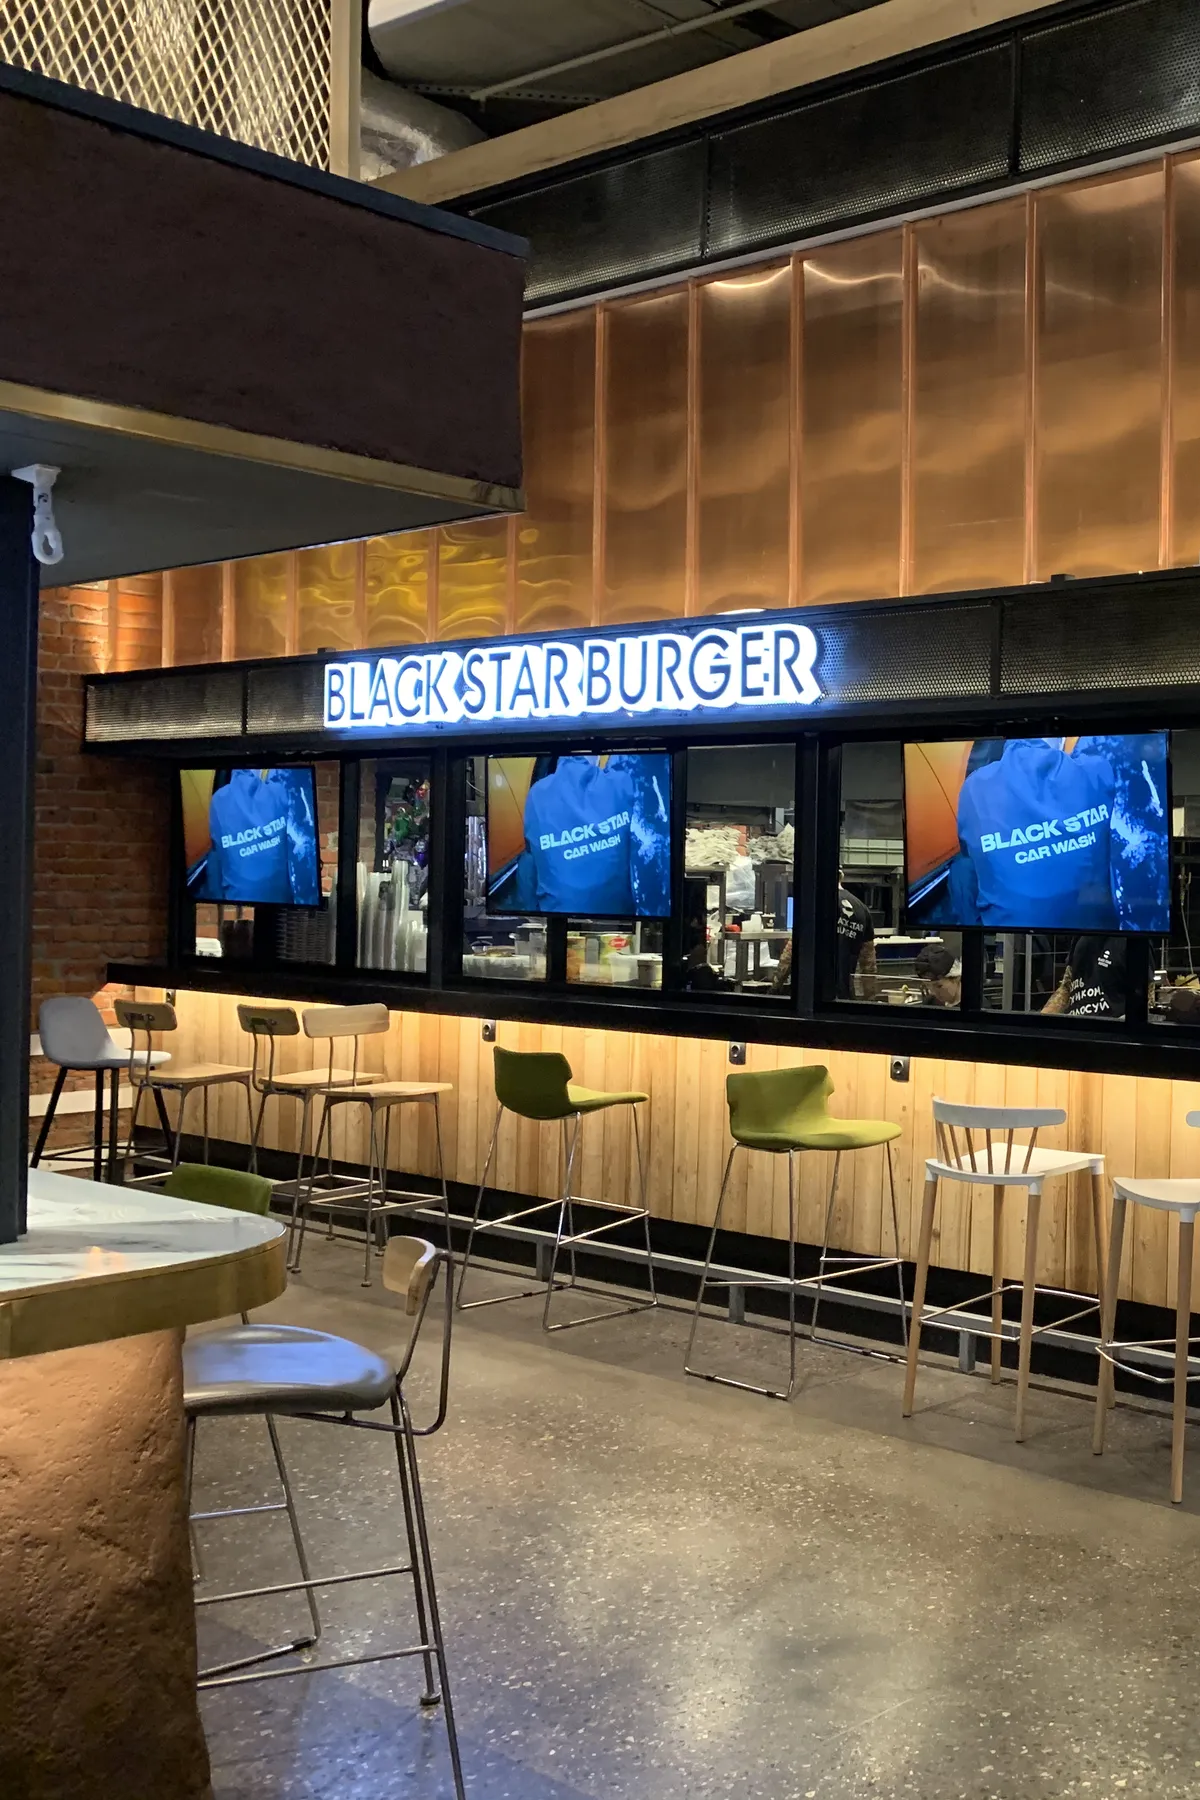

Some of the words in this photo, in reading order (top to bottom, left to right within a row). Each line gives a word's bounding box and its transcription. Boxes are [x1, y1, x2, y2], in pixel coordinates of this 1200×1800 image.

[326, 657, 449, 721] BLACK
[462, 647, 571, 715] STAR
[584, 628, 804, 708] BURGER
[221, 826, 263, 848] BLACK
[263, 816, 286, 836] STAR
[540, 823, 597, 850] BLACK
[598, 811, 630, 834] STAR
[980, 819, 1062, 853] BLACK
[1063, 804, 1109, 832] STAR
[239, 844, 258, 857] CAR
[258, 835, 281, 851] WASH
[563, 845, 589, 860] CAR
[589, 834, 621, 852] WASH
[1015, 846, 1051, 864] CAR
[1051, 832, 1096, 855] WASH
